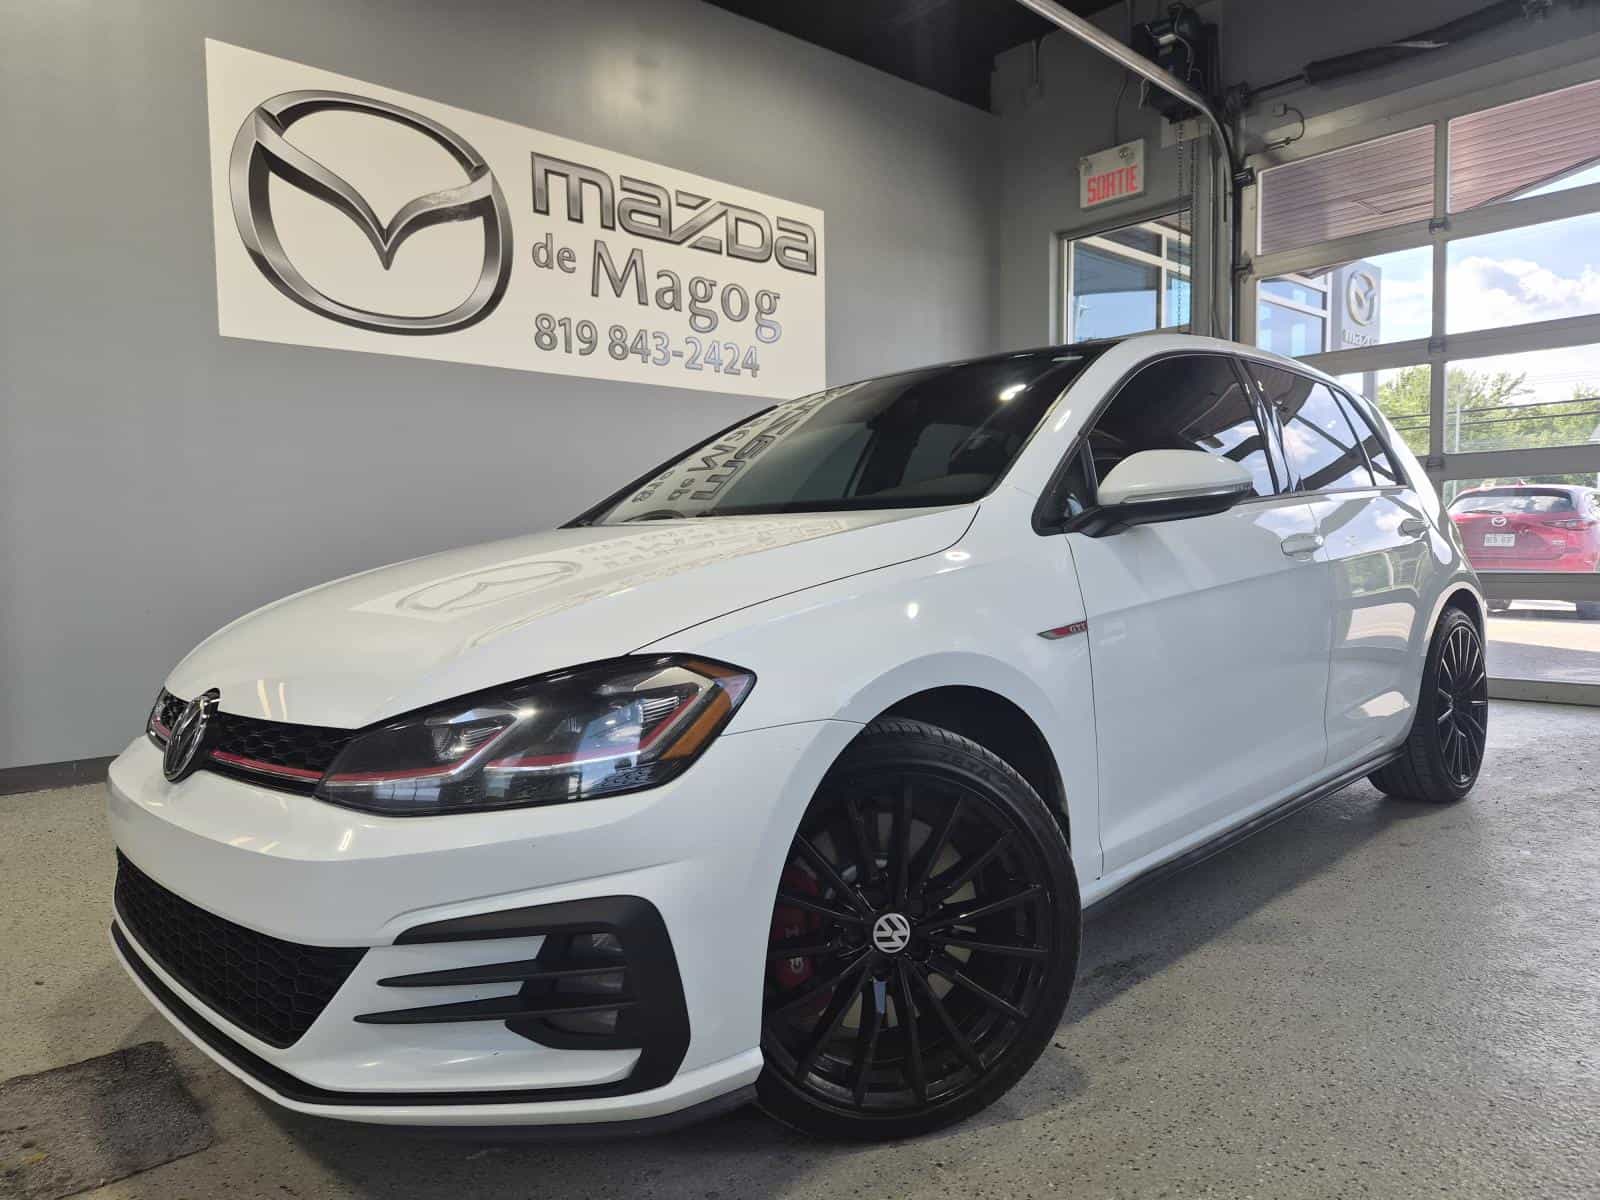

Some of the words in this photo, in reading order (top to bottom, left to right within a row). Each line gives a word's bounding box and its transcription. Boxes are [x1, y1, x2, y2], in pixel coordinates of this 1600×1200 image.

[1087, 165, 1137, 205] SORTIE
[531, 233, 577, 273] de
[591, 239, 782, 344] Magog
[534, 313, 598, 356] 819
[608, 325, 760, 378] 843-2424
